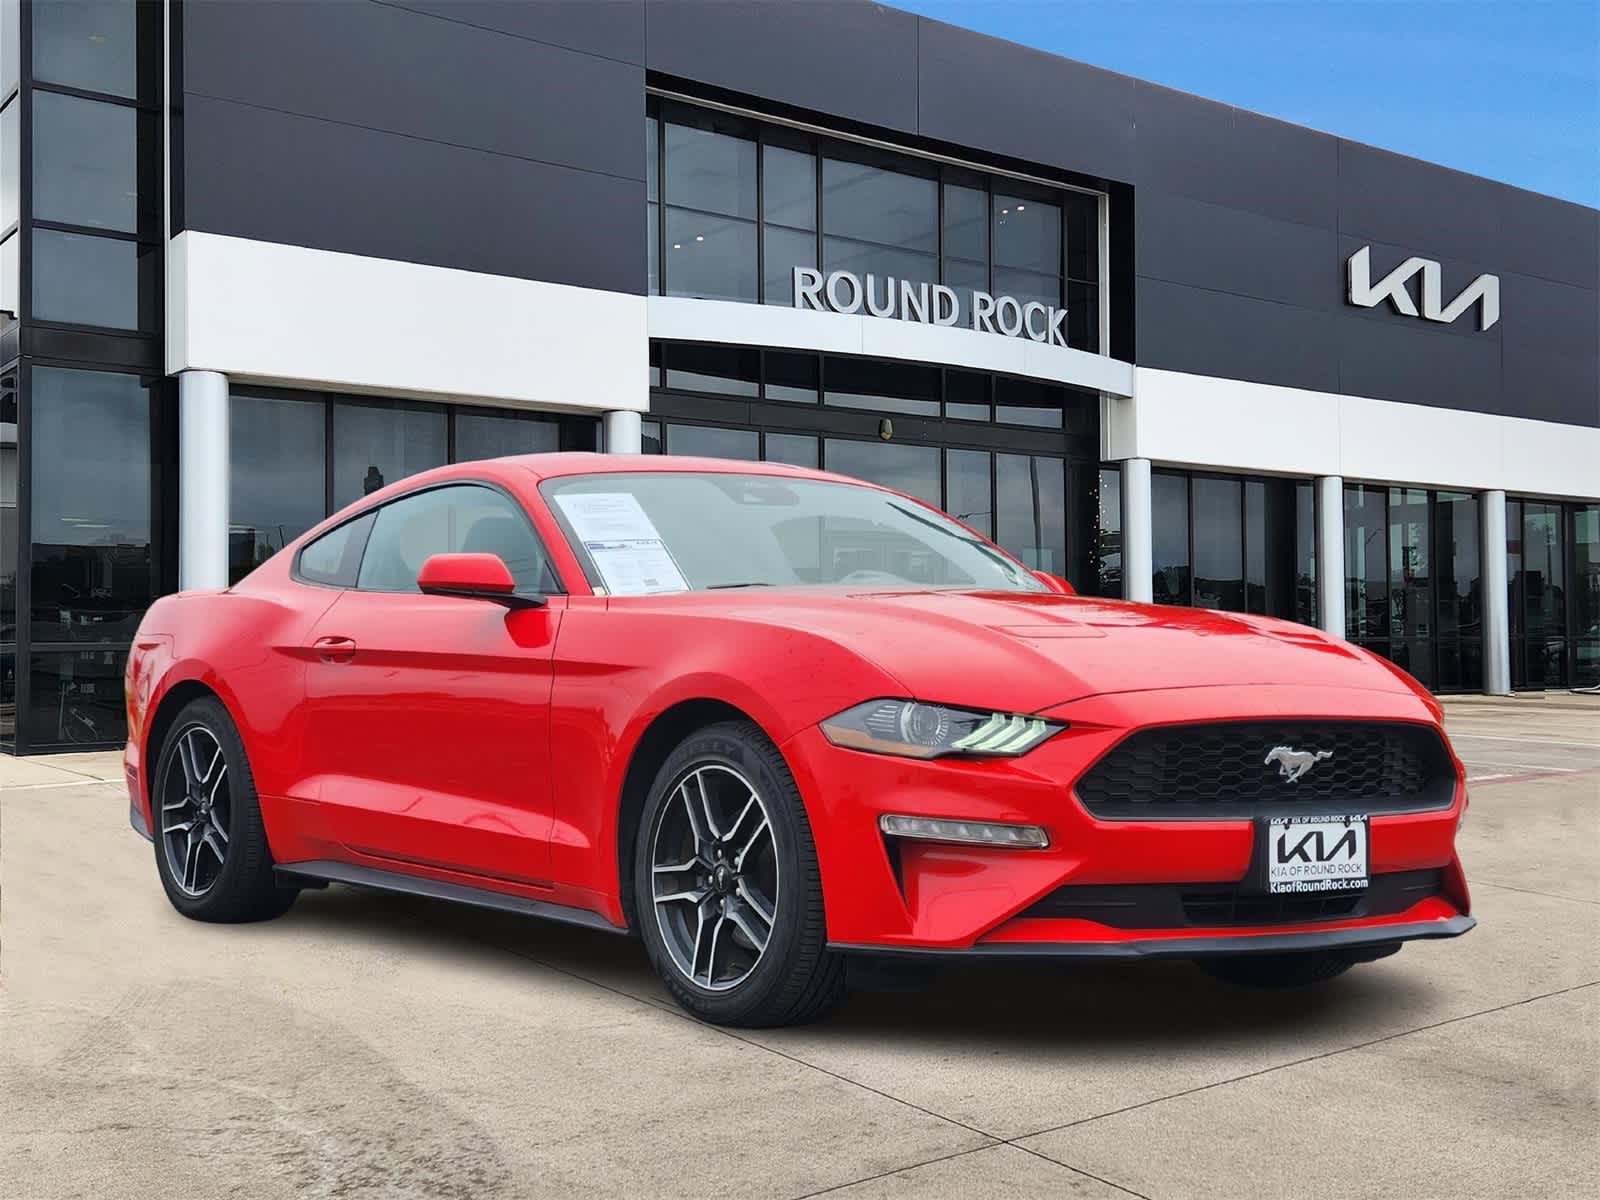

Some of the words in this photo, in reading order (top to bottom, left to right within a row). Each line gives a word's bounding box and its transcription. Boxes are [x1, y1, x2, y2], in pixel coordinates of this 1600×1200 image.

[1347, 245, 1500, 331] KIA
[793, 266, 960, 327] ROUND
[972, 290, 1069, 348] ROCK
[1277, 829, 1357, 864] KIA
[1270, 878, 1369, 894] KiaofRoundRock.com
[1271, 866, 1288, 877] KIA
[1289, 865, 1303, 877] OF
[1303, 864, 1336, 876] ROUND
[1338, 863, 1362, 873] ROCK
